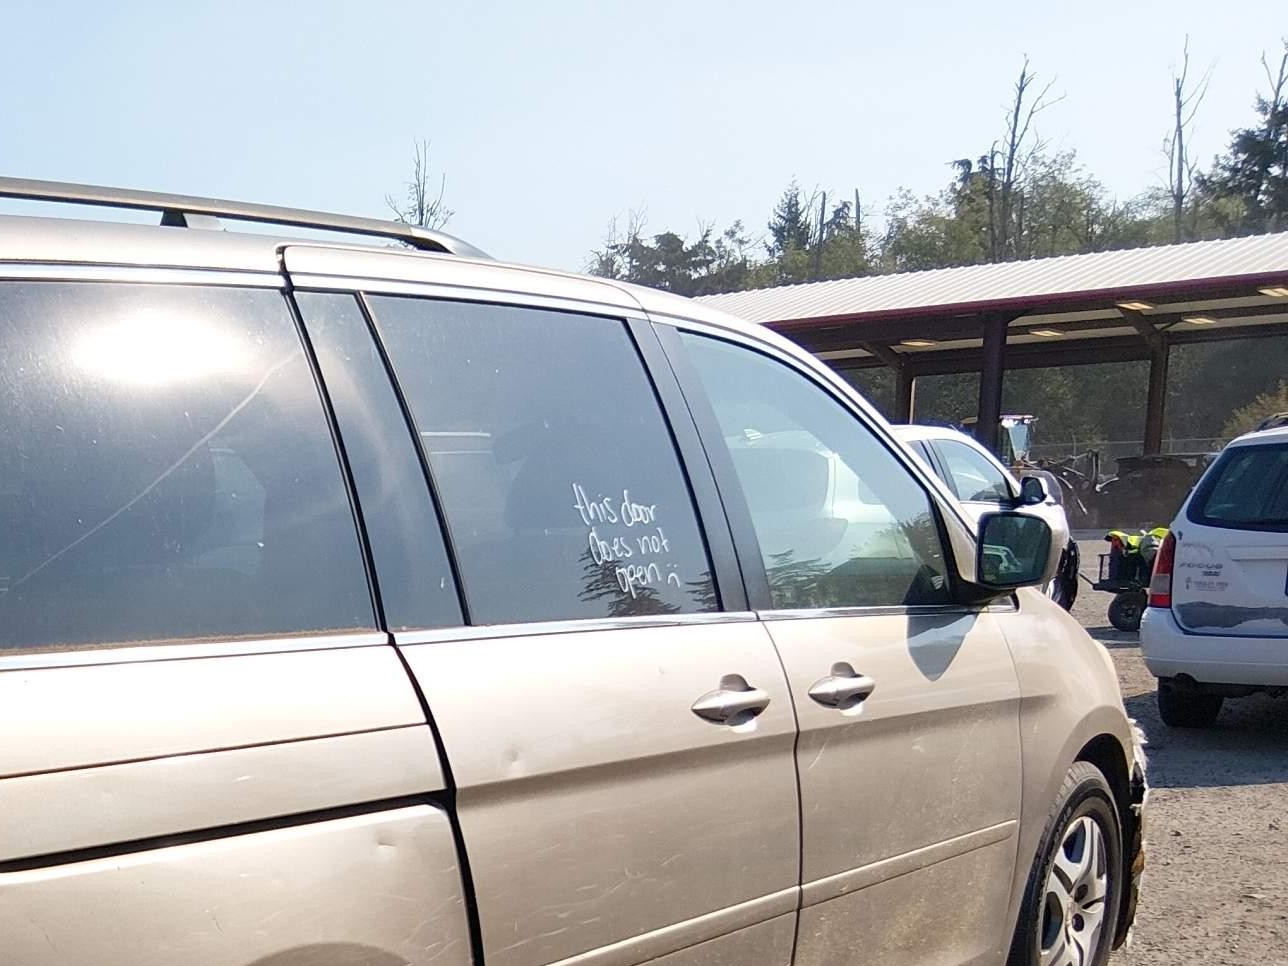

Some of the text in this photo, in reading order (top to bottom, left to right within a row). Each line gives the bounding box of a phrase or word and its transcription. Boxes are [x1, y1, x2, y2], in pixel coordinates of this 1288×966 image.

[572, 483, 656, 527] this door
[589, 526, 669, 565] does not
[615, 563, 661, 599] open
